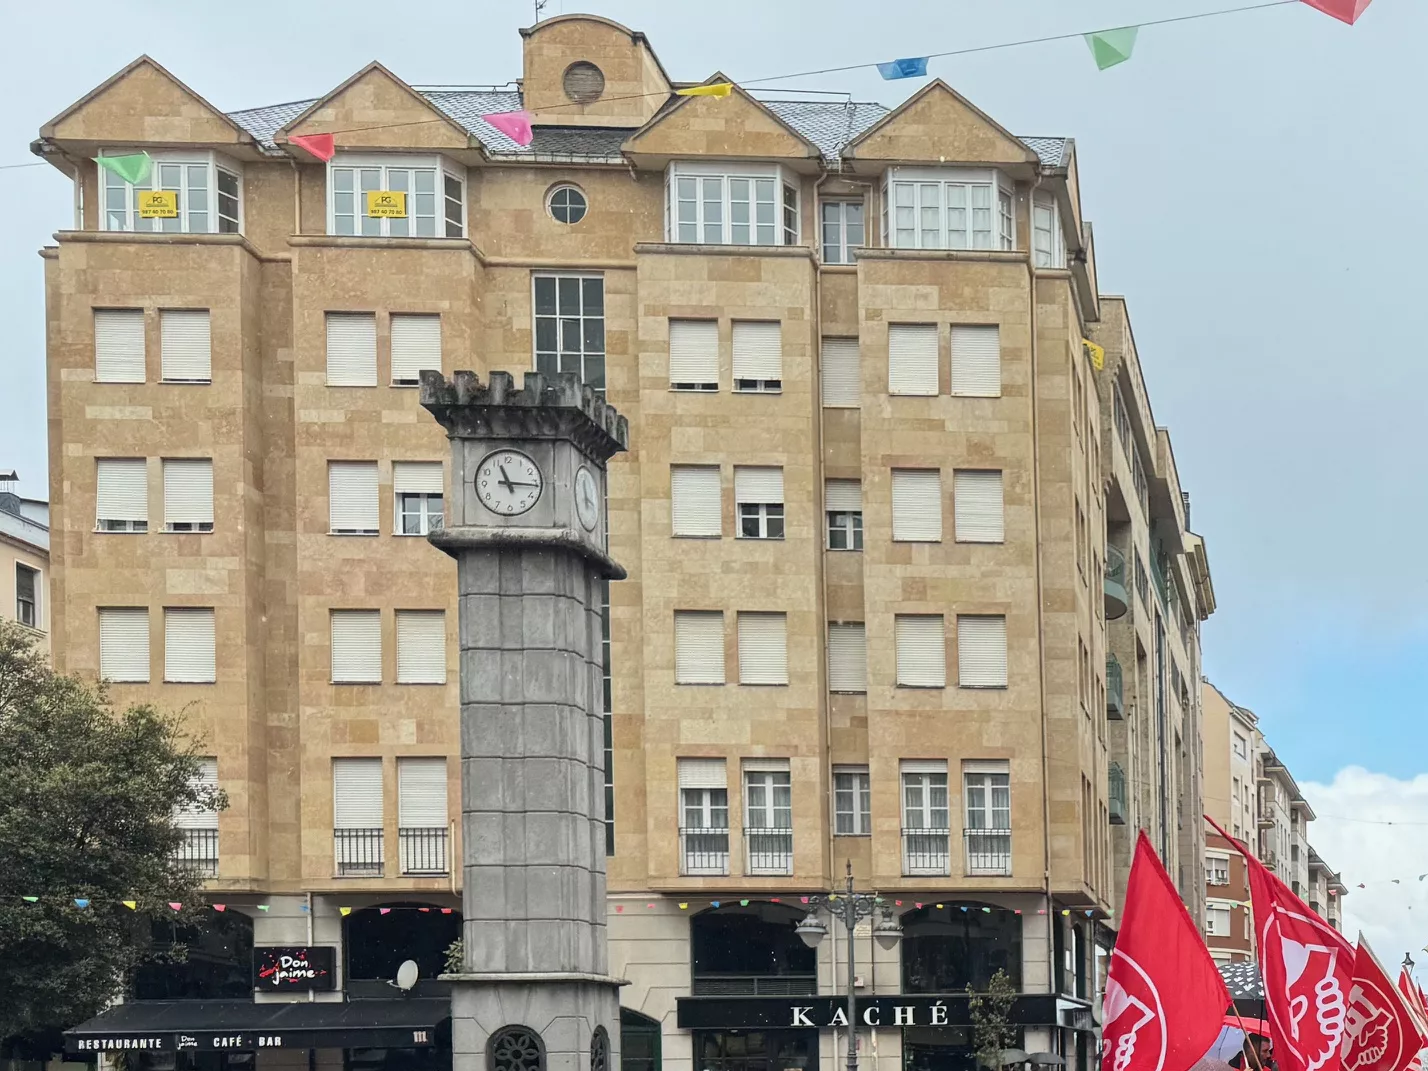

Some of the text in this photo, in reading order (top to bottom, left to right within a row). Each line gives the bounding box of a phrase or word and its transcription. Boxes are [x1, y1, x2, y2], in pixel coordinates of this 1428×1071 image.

[504, 456, 513, 464] 12
[483, 468, 491, 476] 10
[526, 468, 534, 476] 2
[481, 480, 488, 488] 9
[485, 493, 491, 501] 8
[527, 491, 534, 499] 4
[494, 501, 501, 511] 7
[520, 501, 526, 509] 5
[280, 955, 309, 969] Don
[272, 968, 315, 985] jaime
[790, 1001, 949, 1026] KACHÉ
[78, 1038, 162, 1050] RESTAURANTE
[213, 1035, 282, 1048] CAFÉ BAR
